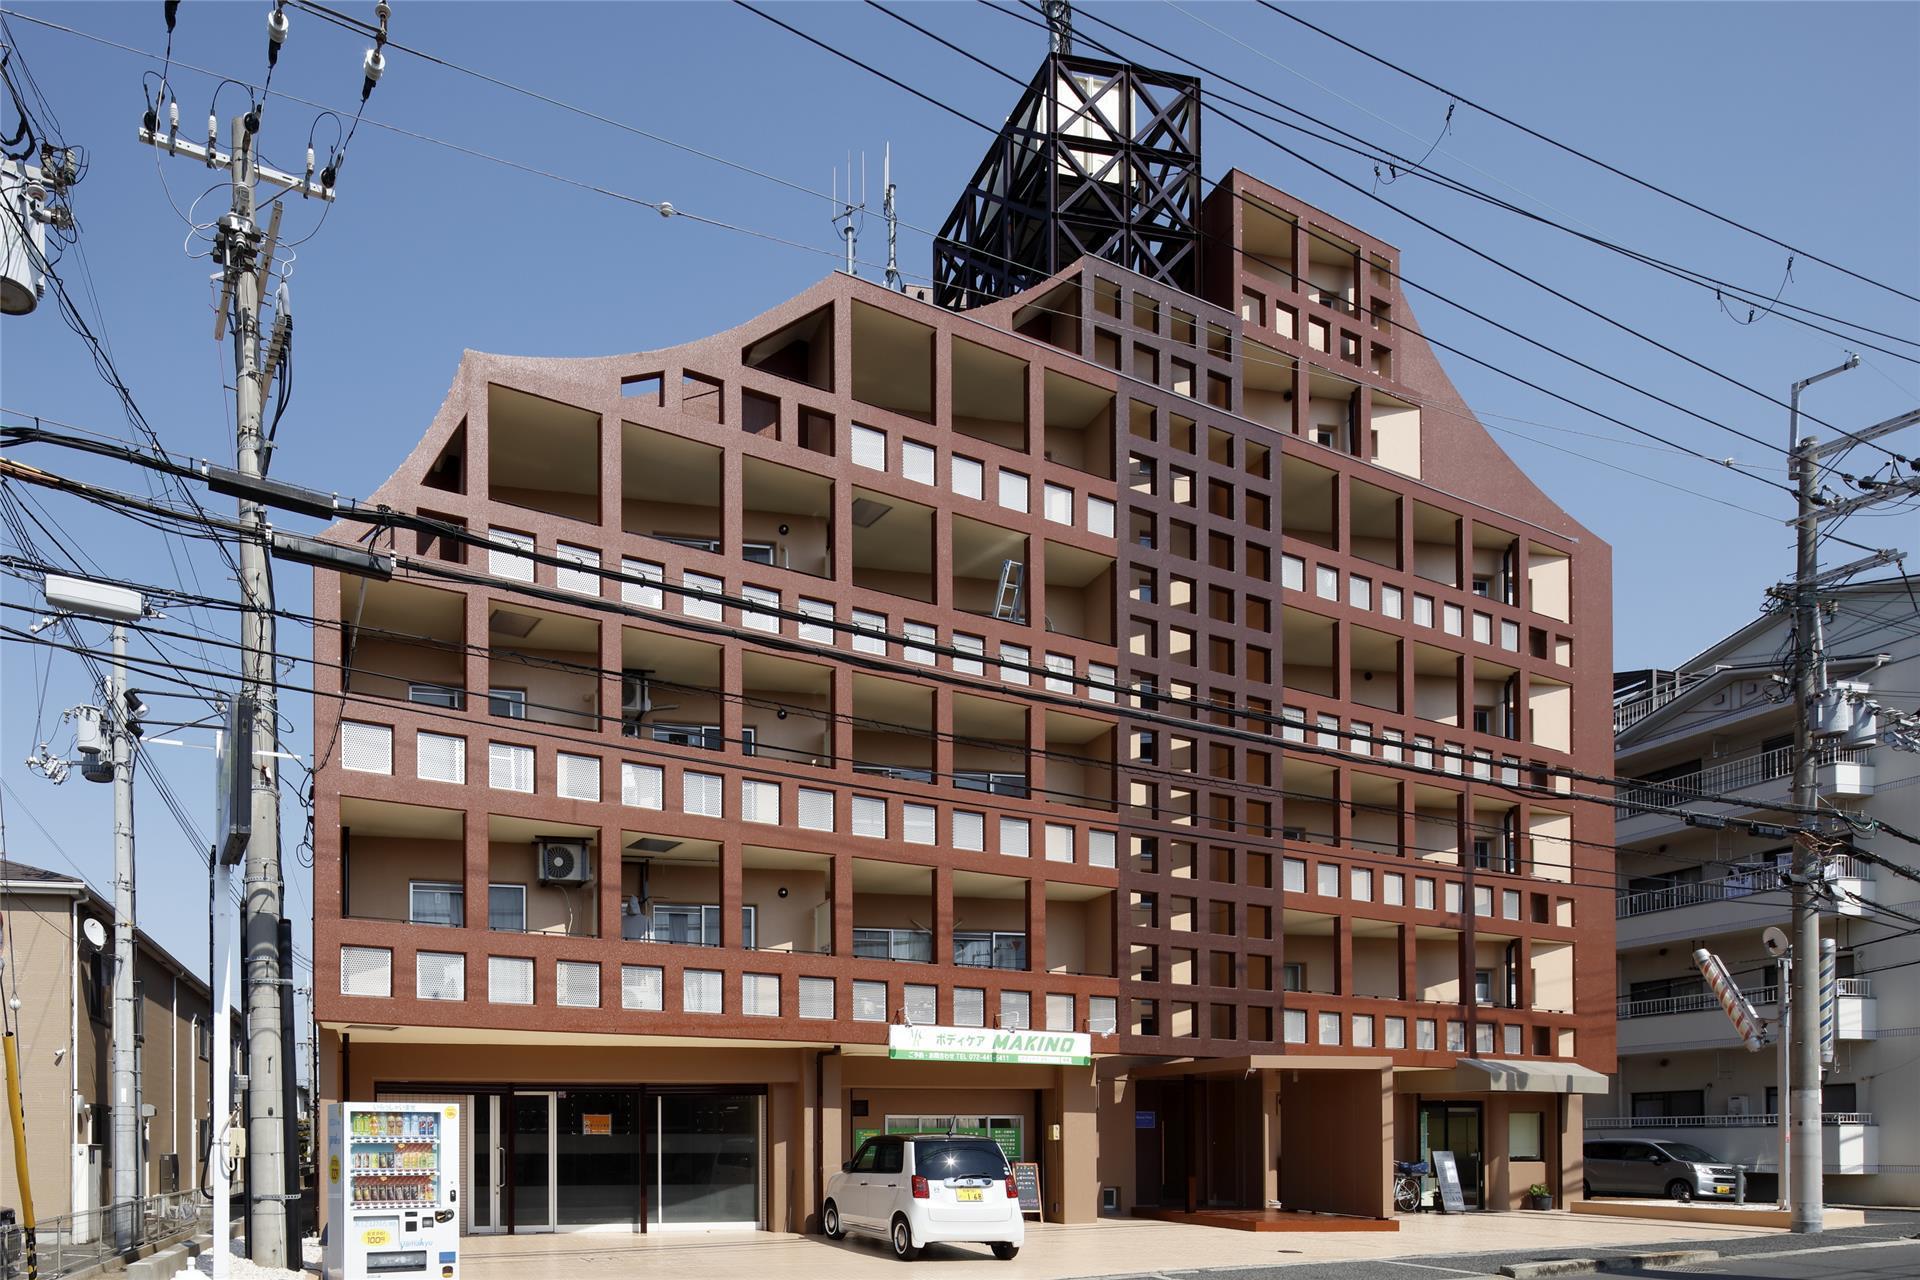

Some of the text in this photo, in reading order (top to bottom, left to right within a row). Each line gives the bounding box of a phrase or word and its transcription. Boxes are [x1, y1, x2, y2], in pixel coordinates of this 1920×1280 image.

[936, 1034, 1075, 1052] ボディケア MAKINO
